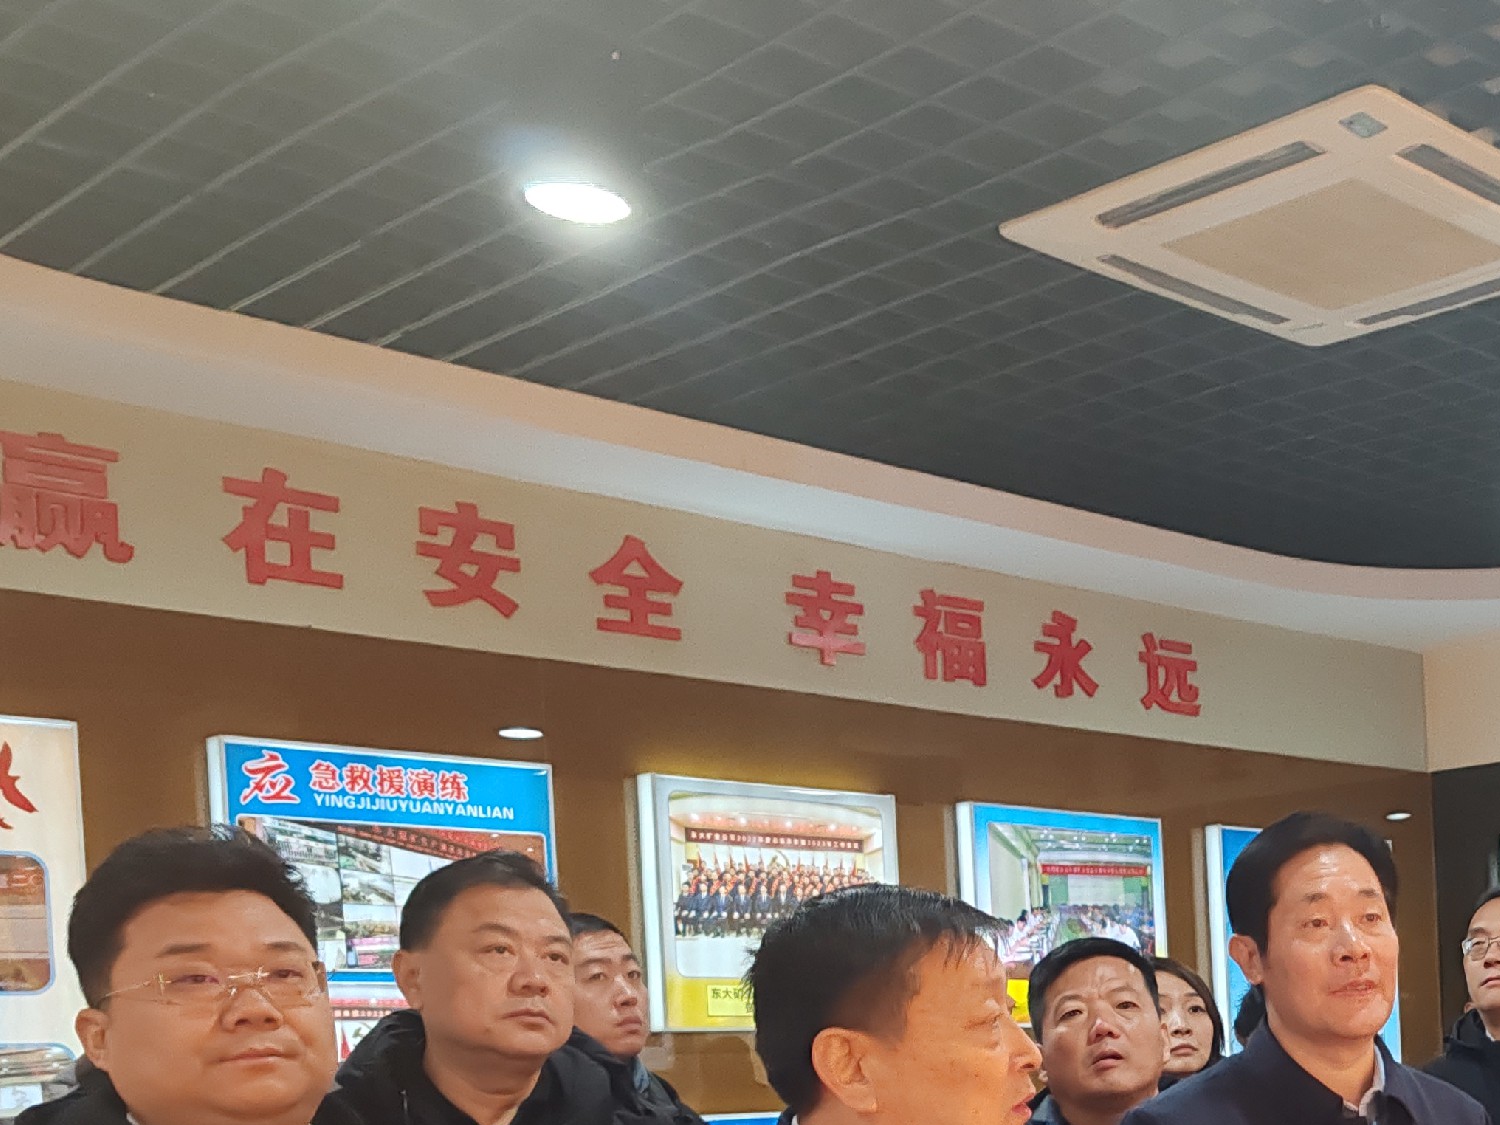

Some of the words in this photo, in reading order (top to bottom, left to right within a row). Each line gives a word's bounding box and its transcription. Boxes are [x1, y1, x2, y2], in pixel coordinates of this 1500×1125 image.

[786, 569, 1202, 717] 幸福永远
[314, 794, 514, 820] YINGJIJIUYUANYANLIAN
